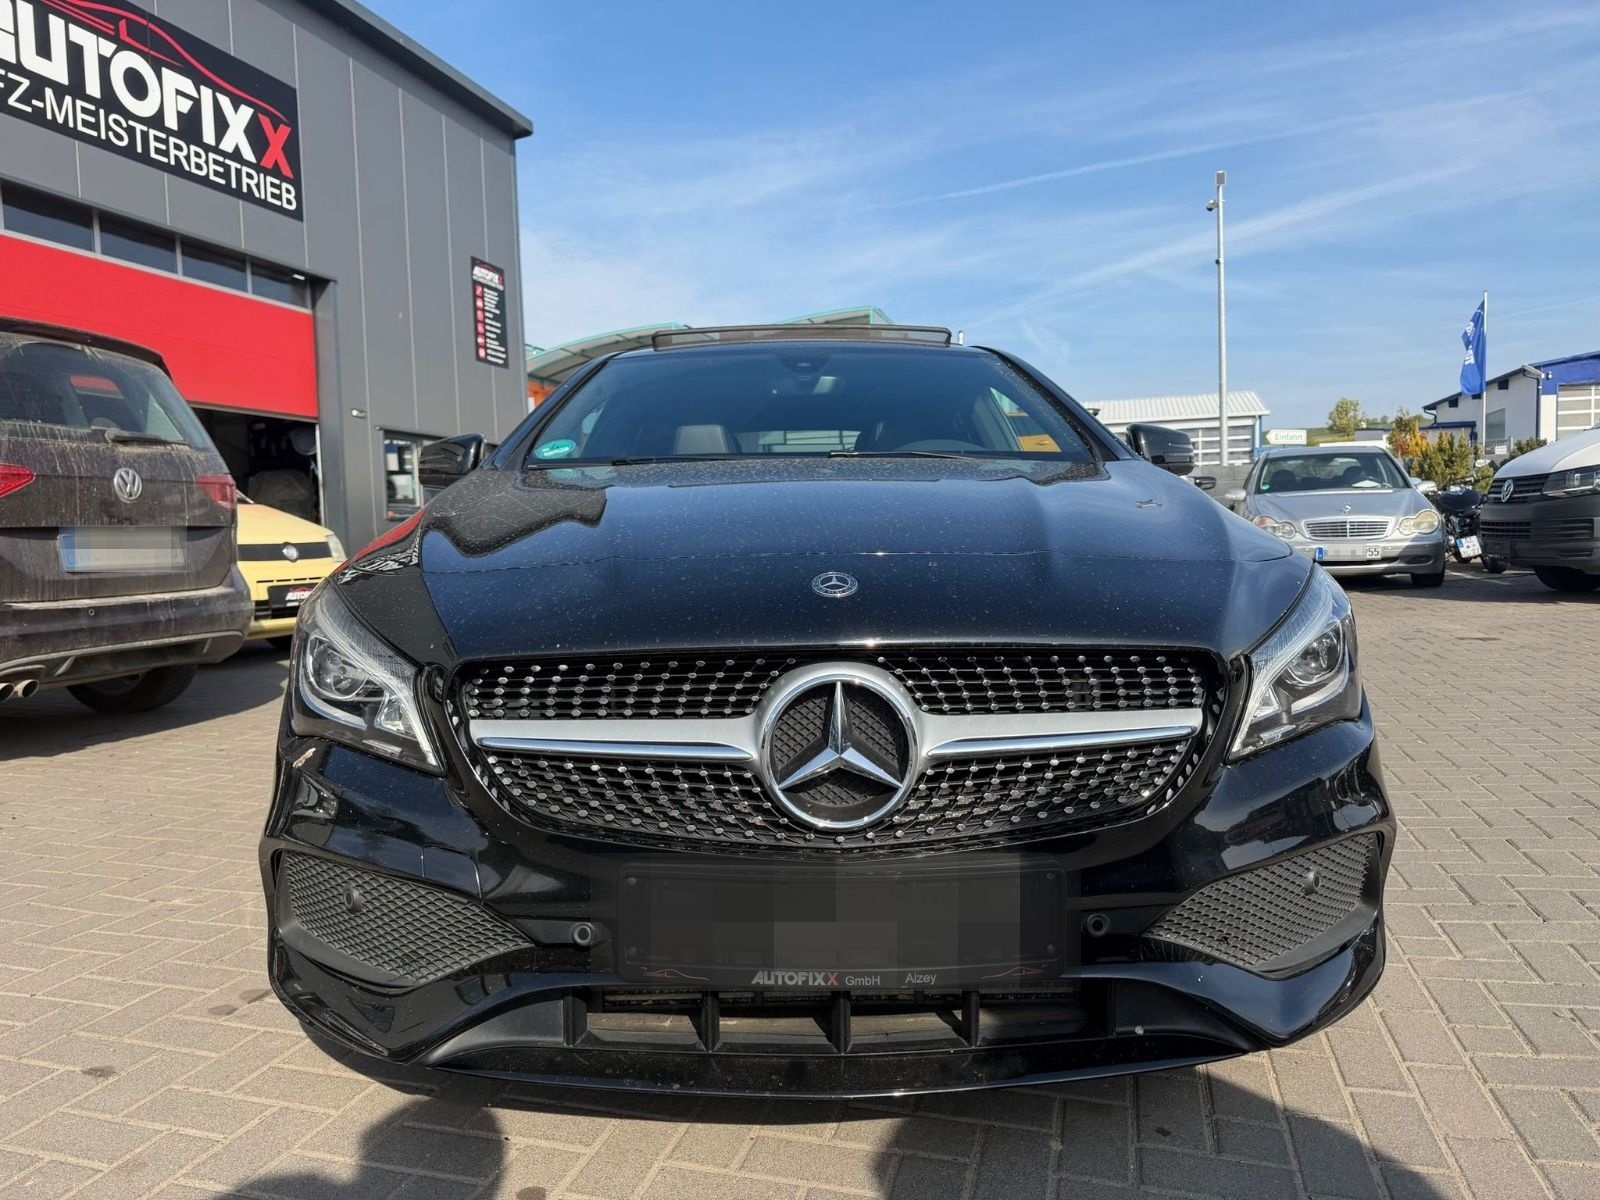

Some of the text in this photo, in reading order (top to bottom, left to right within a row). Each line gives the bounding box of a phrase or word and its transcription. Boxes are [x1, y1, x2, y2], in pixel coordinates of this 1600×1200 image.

[1274, 432, 1303, 441] Einfahrt
[1367, 547, 1380, 557] 55
[751, 970, 937, 986] AUTOFIXX GmbH Alzey
